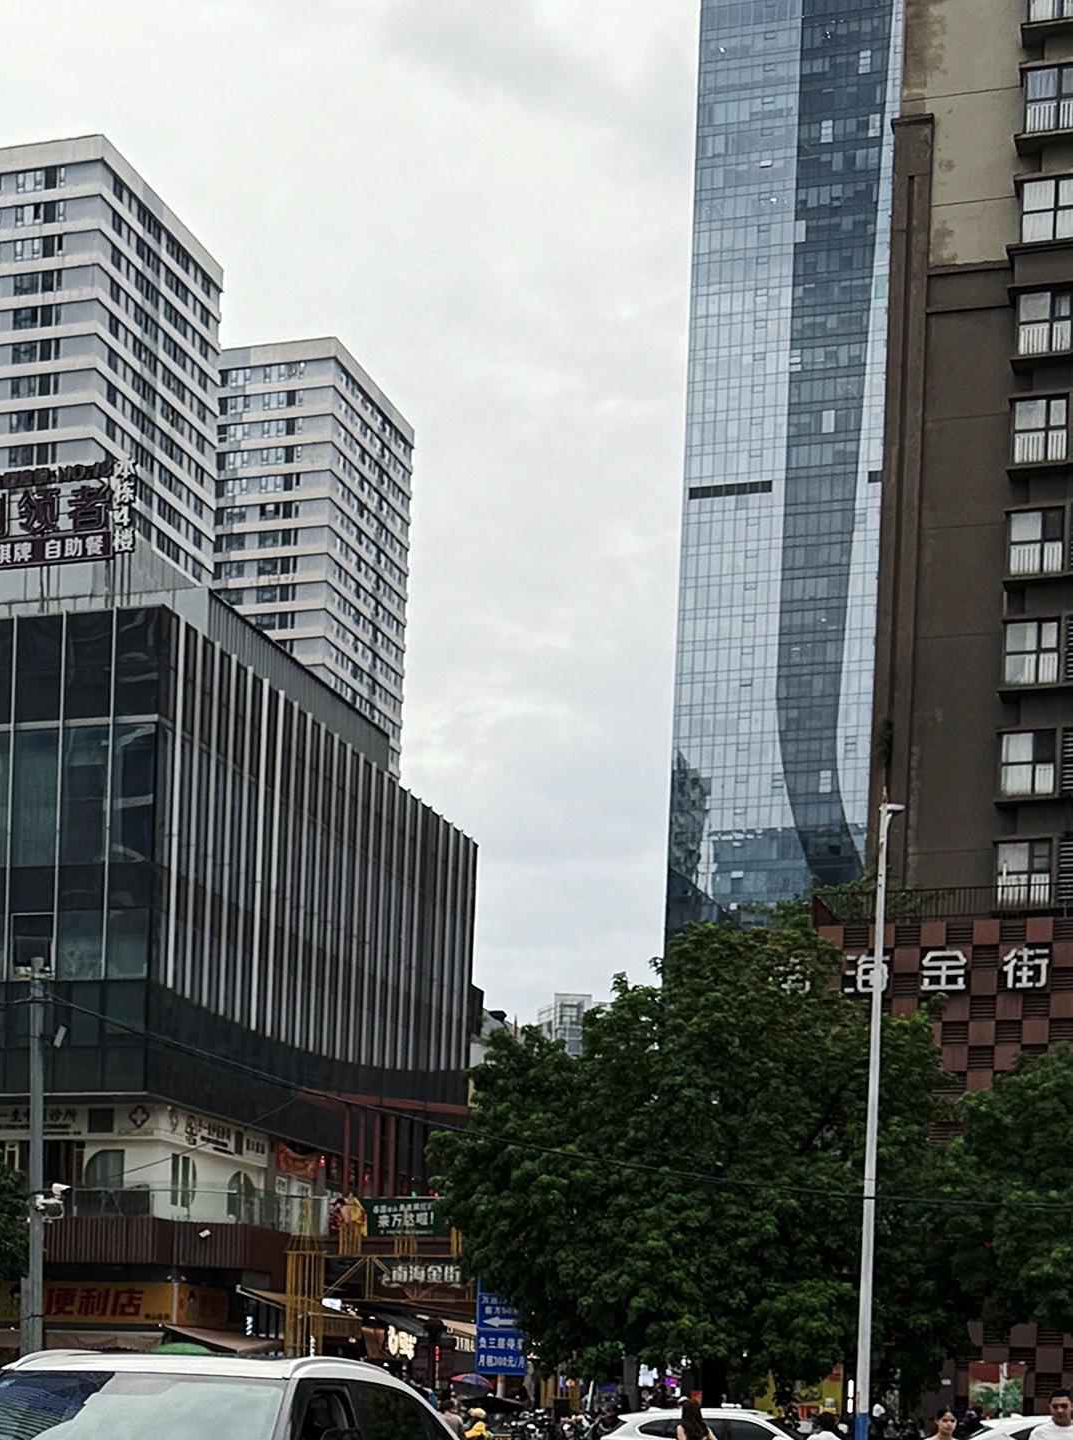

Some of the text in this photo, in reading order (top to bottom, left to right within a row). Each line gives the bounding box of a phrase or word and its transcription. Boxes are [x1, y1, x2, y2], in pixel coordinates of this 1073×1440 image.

[45, 535, 104, 560] 自助餐
[45, 1286, 144, 1318] 便利店
